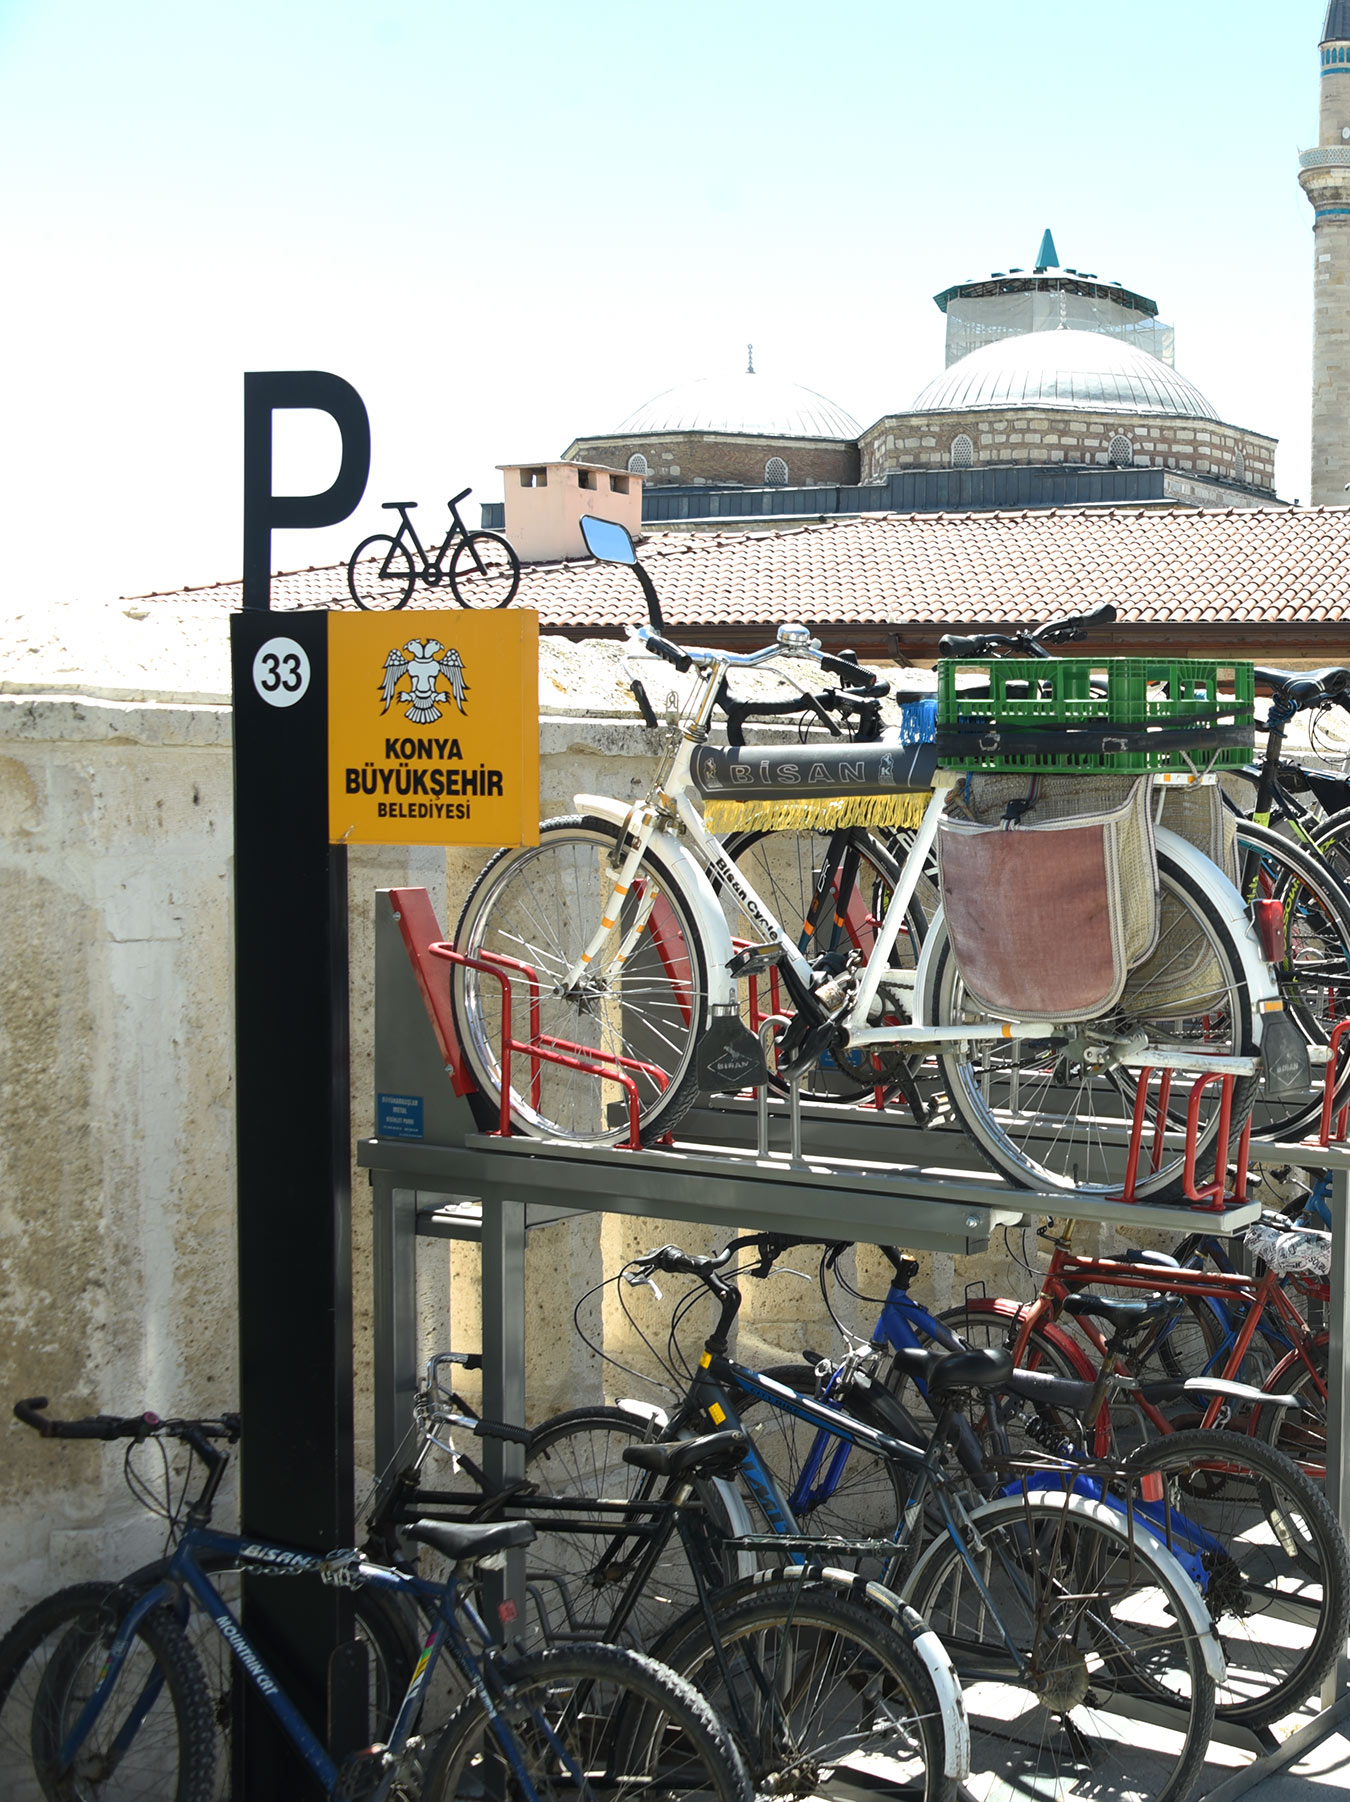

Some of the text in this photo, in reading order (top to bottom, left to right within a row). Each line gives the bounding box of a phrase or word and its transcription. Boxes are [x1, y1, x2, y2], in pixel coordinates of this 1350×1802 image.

[242, 370, 371, 610] P
[261, 653, 302, 692] 33
[385, 737, 463, 761] KONYA
[345, 762, 503, 800] BÜYÜKŞEHİR
[730, 760, 866, 785] BİSAN
[377, 801, 471, 821] BELEDİYESİ
[216, 1615, 279, 1696] MOUNTAIN CAT
